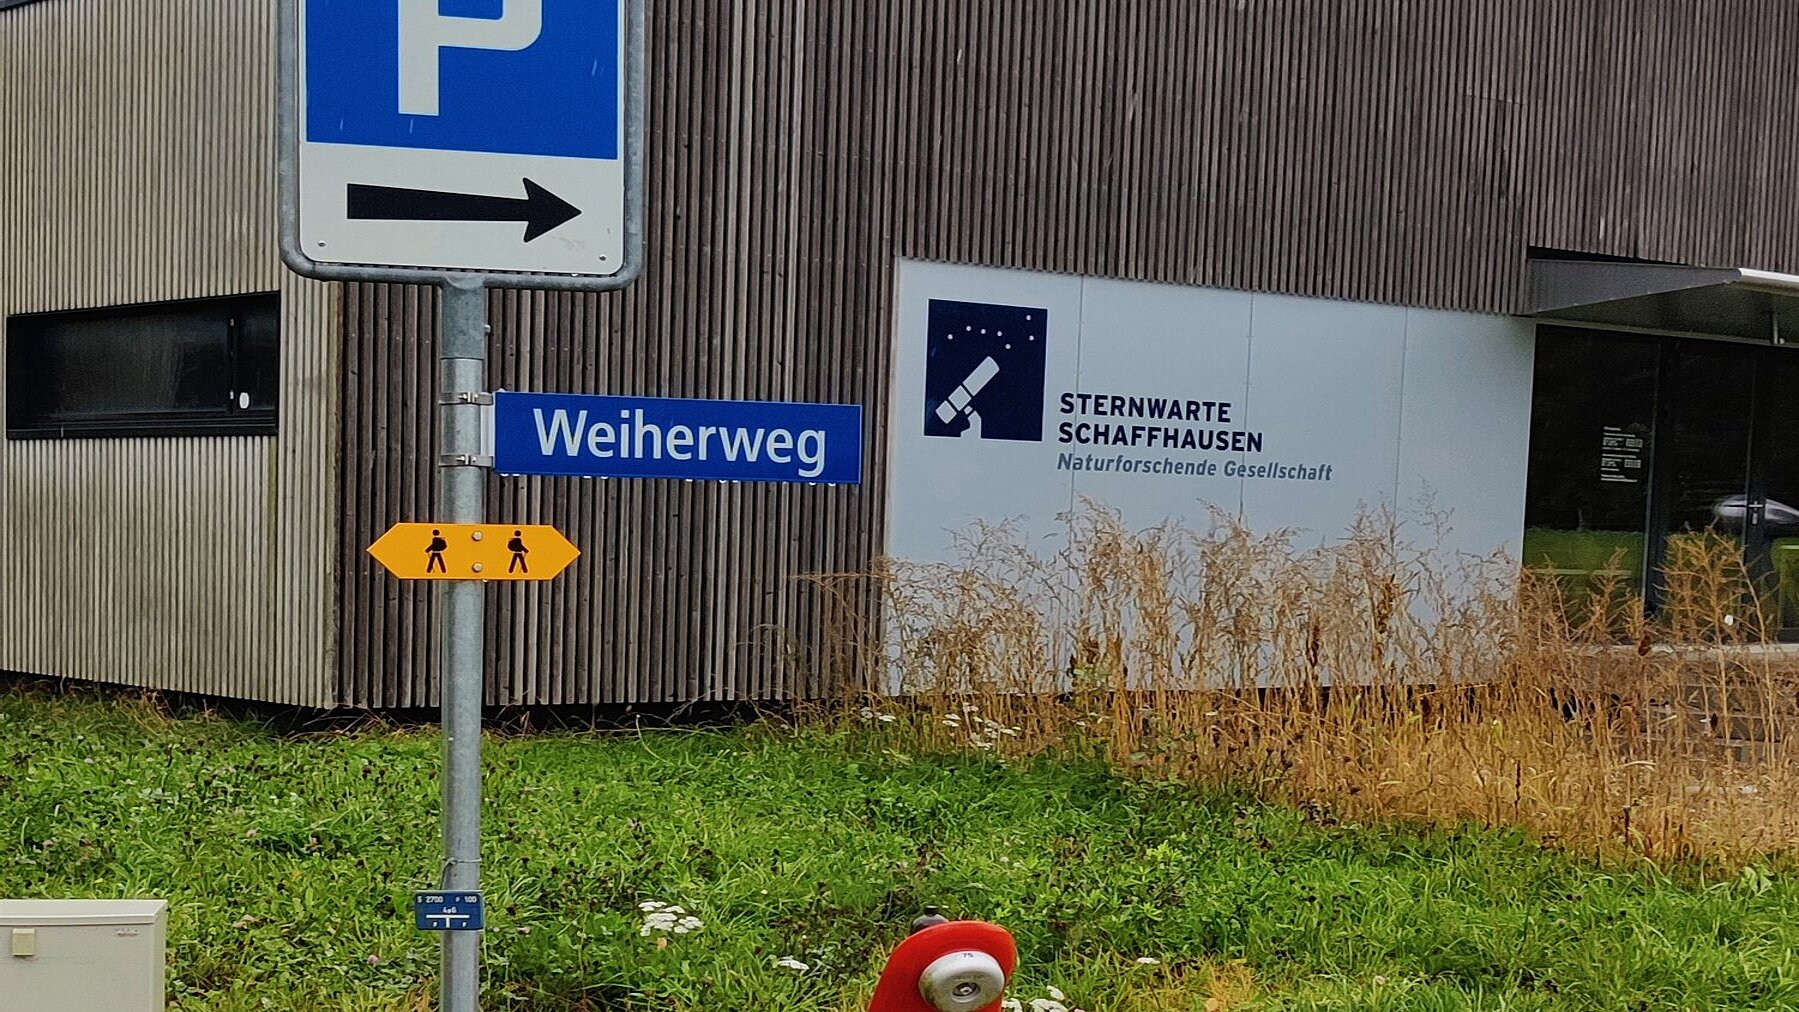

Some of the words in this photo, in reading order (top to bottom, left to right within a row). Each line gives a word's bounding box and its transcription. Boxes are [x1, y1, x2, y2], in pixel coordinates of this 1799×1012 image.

[398, 0, 542, 116] P
[1059, 392, 1232, 423] STERNWARTE
[533, 408, 826, 477] Weiherweg
[1058, 422, 1263, 452] SCHAFFHAUSEN
[1057, 453, 1217, 476] Naturforschende
[1224, 460, 1332, 481] Gesellschaft
[425, 895, 444, 903] 2700
[464, 895, 477, 903] 100
